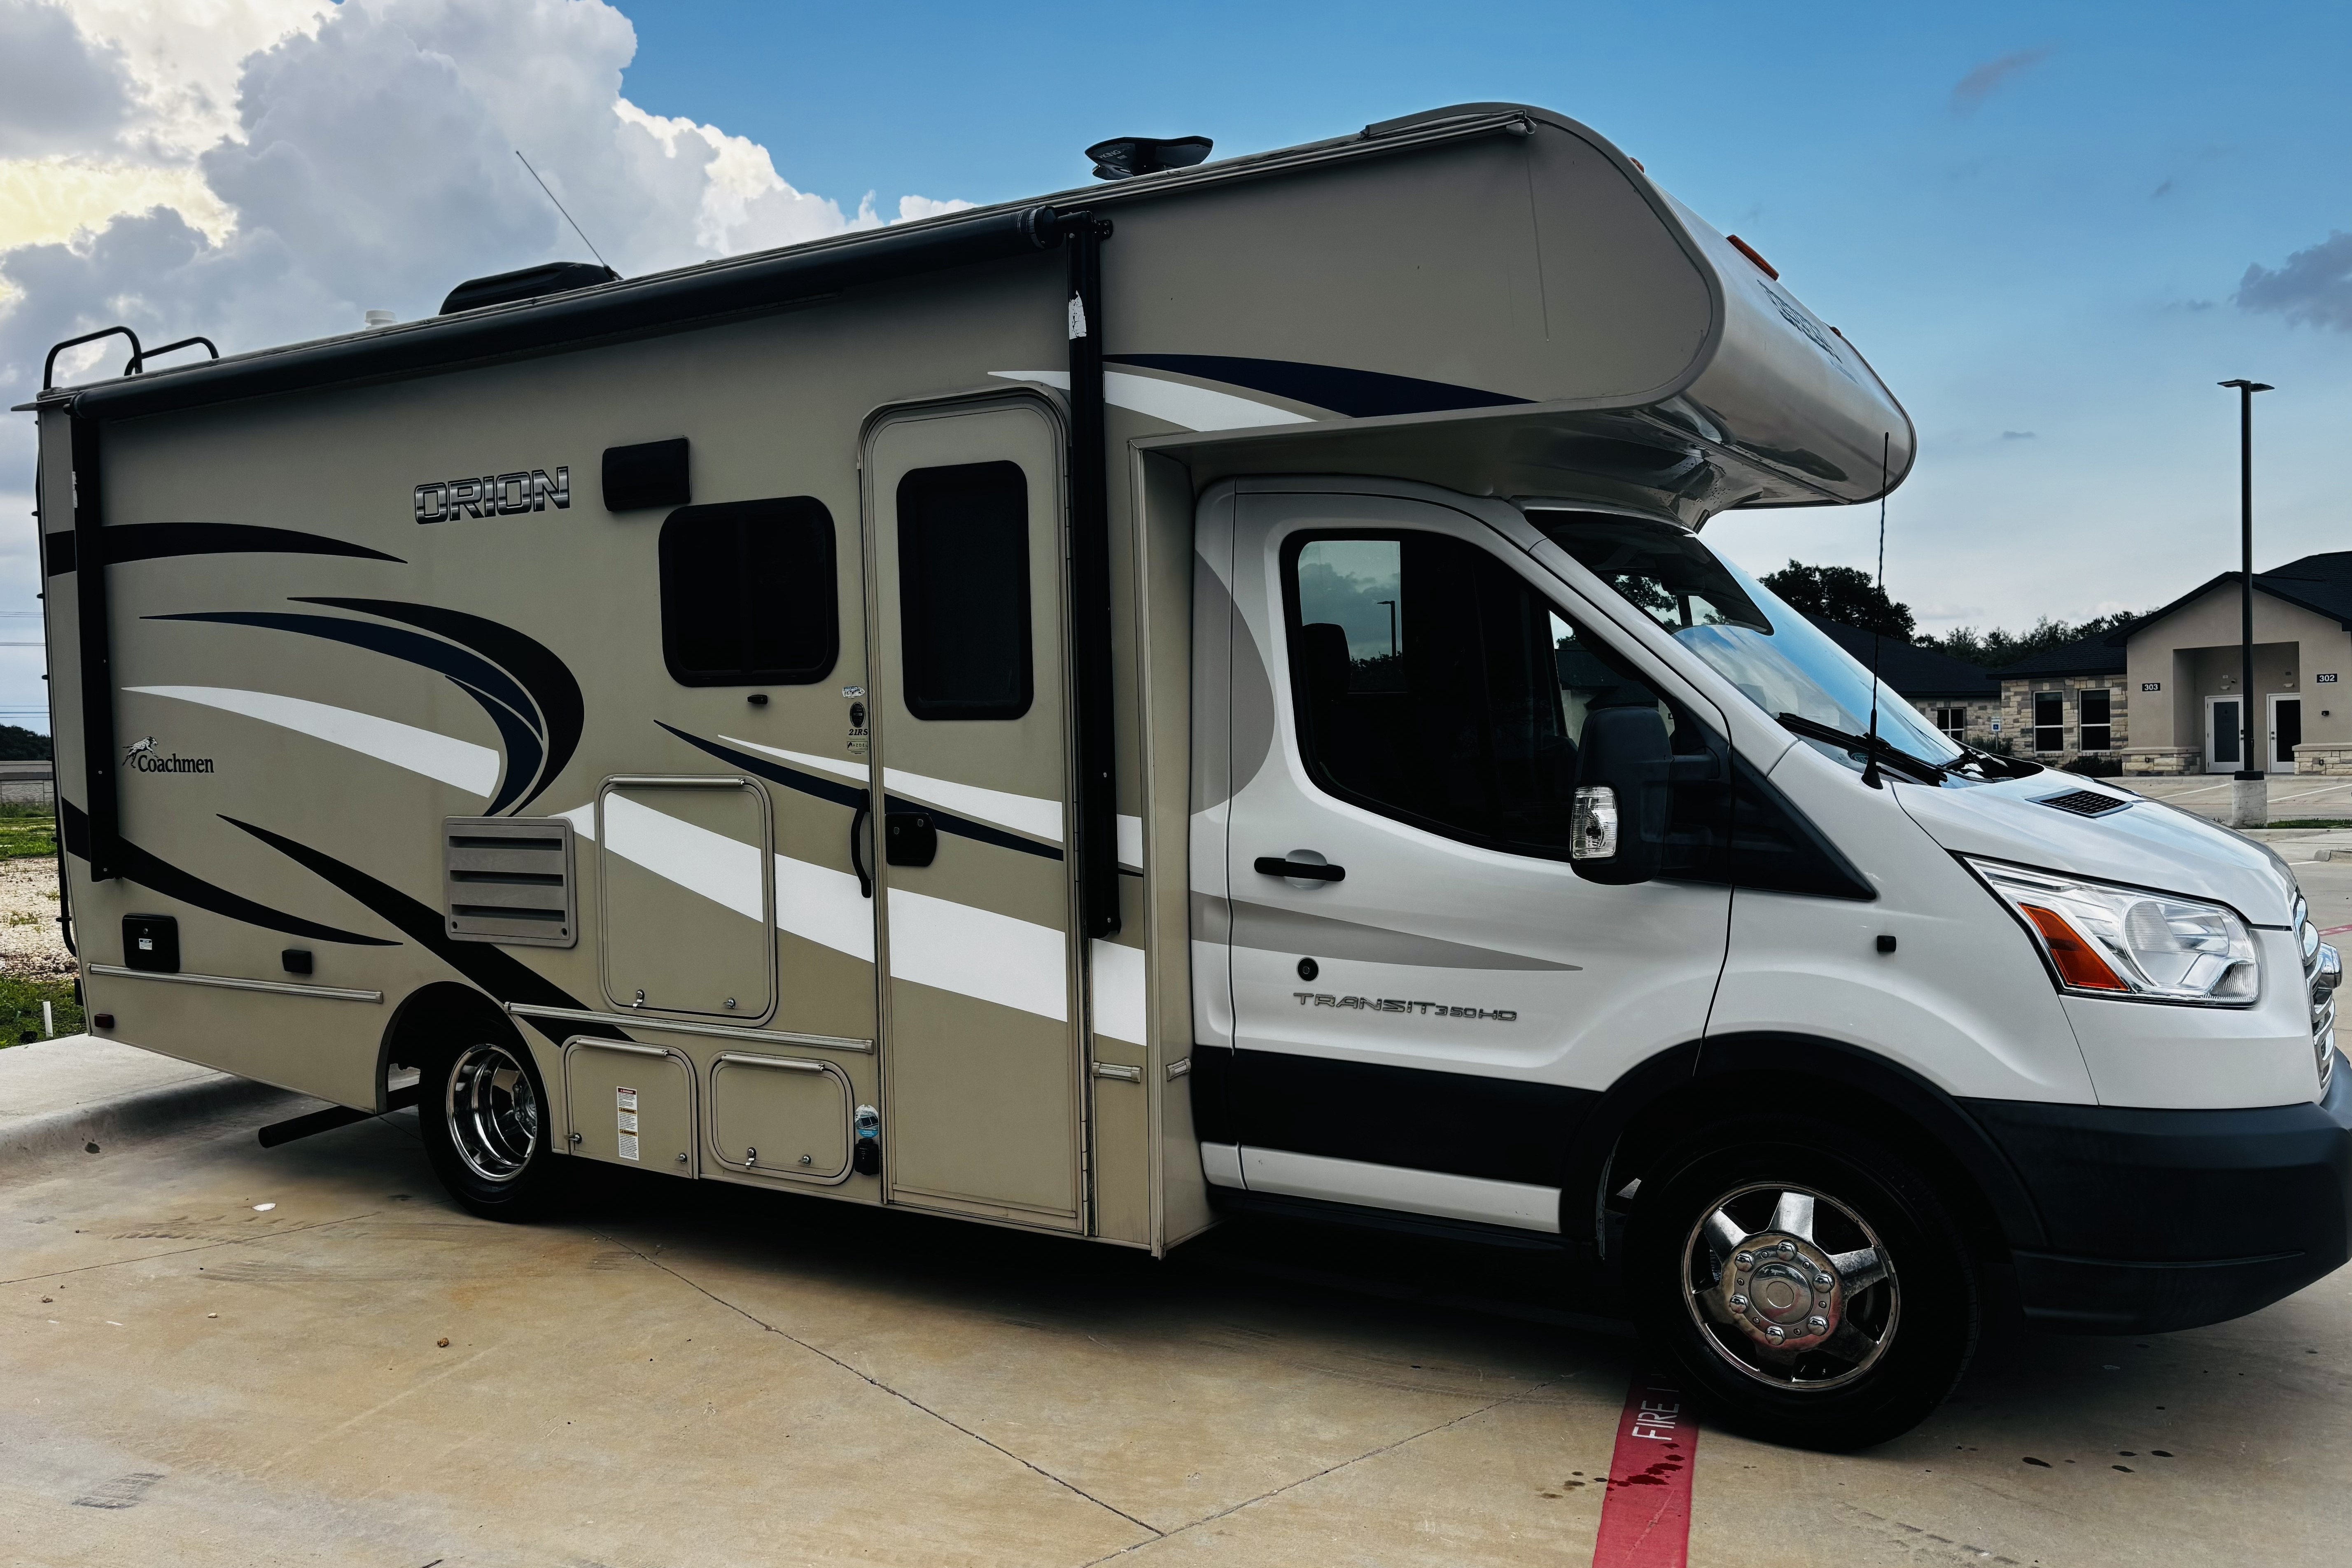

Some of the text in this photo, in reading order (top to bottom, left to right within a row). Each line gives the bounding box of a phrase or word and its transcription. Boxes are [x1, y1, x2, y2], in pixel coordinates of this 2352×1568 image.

[415, 466, 570, 525] ORION
[138, 753, 214, 773] Coachmen
[1632, 1400, 1680, 1440] FIRE
